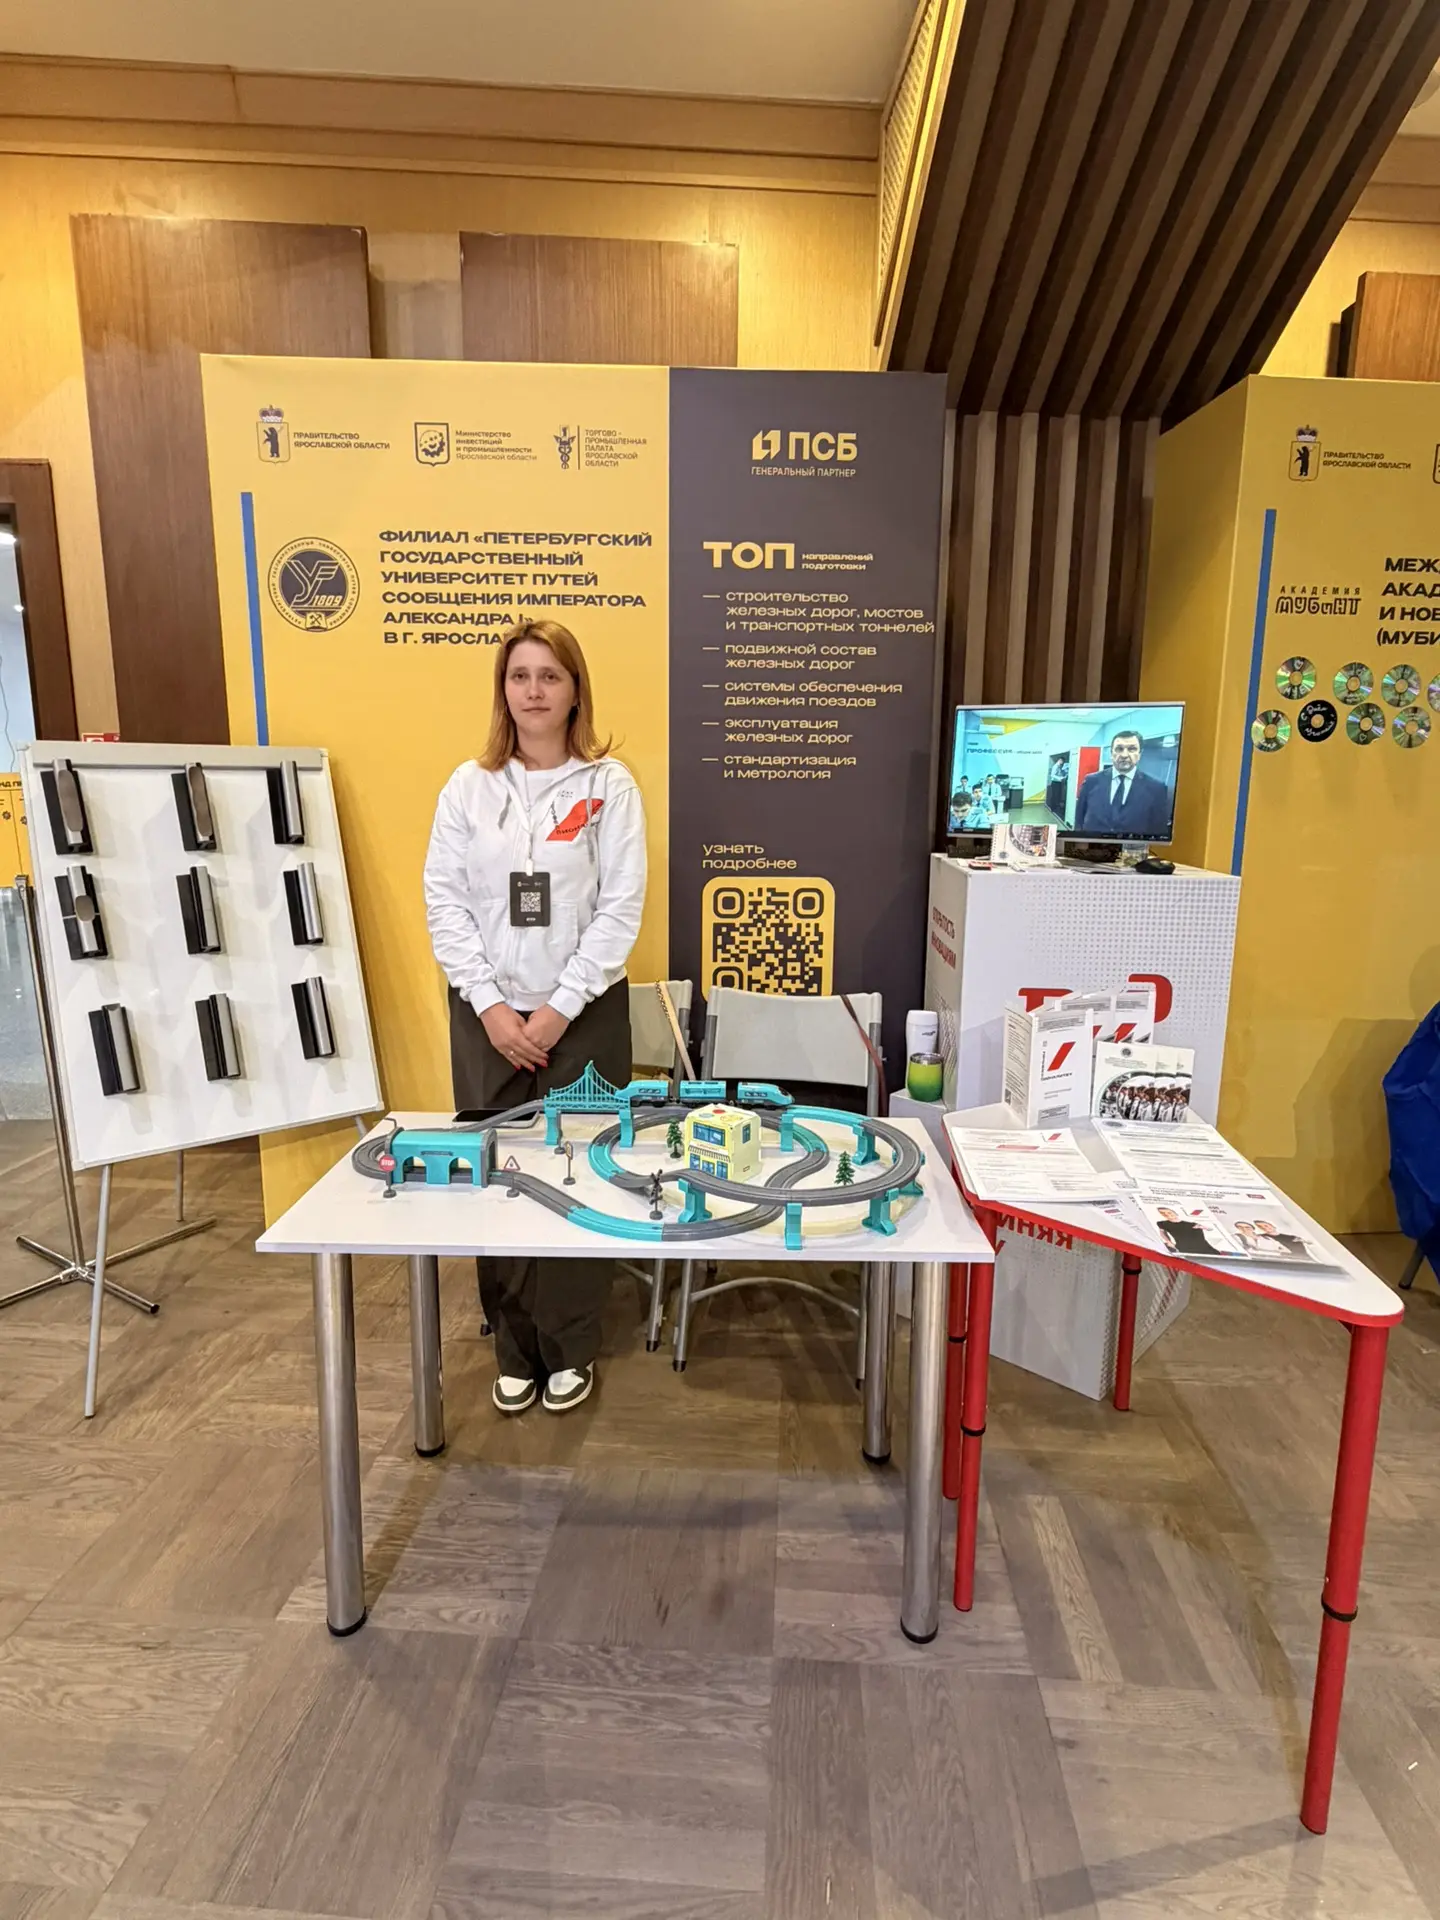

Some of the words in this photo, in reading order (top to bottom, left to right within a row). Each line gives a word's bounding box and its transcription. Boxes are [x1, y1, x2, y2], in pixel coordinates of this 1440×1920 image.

[293, 432, 360, 440] ПРАВИТЕЛЬСТВО
[455, 431, 511, 439] Министерство
[585, 437, 647, 445] ПРОМЫШЛЕННАЯ
[294, 440, 353, 449] ЯРОСЛАВСКОЙ
[353, 441, 390, 449] ОБЛАСТИ
[455, 438, 503, 446] инвестиций
[788, 431, 858, 461] ПСБ
[462, 446, 532, 454] промышленности
[585, 452, 638, 460] ЯРОСЛАВСКОЙ
[1323, 451, 1385, 459] ПРАВИТЕЛЬСТВО
[585, 459, 619, 467] ОБЛАСТИ
[1322, 460, 1376, 469] ЯРОСЛАВСКОЙ
[1377, 461, 1411, 470] ОБЛАСТИ
[751, 466, 815, 476] ГЕНЕРАЛЬНЫЙ
[817, 467, 856, 478] ПАРТНЕР
[379, 530, 469, 543] ФИЛИАЛ
[474, 531, 652, 547] «ПЕТЕРБУРГСКИЙ
[380, 550, 583, 566] ГОСУДАРСТВЕННЫЙ
[703, 541, 796, 569] ТОП
[802, 552, 874, 562] направлений
[802, 562, 866, 571] подготовки
[1384, 557, 1440, 574] МЕЖ
[381, 571, 528, 585] УНИВЕРСИТЕТ
[532, 571, 598, 586] ПУТЕЙ
[1280, 585, 1361, 596] АКАДЕМИЯ
[311, 595, 343, 607] 1809
[382, 591, 513, 606] СООБЩЕНИЯ
[517, 593, 647, 607] ИМПЕРАТОРА
[726, 591, 849, 604] строительство
[383, 611, 514, 626] АЛЕКСАНДРА
[726, 606, 806, 617] железных
[810, 607, 860, 621] дорог,
[864, 608, 924, 619] мостов
[1379, 606, 1396, 620] И
[726, 621, 735, 630] и
[740, 621, 854, 634] транспортных
[859, 621, 935, 633] тоннелей
[384, 632, 398, 643] В
[402, 632, 418, 644] Г.
[421, 632, 503, 645] ЯРОСЛА
[725, 644, 816, 658] подвижной
[820, 645, 877, 656] состав
[725, 658, 805, 669] железных
[809, 659, 855, 671] дорог
[724, 681, 795, 692] системы
[799, 681, 902, 693] обеспечения
[724, 696, 805, 707] движения
[808, 697, 876, 708] поездов
[725, 718, 839, 731] эксплуатация
[725, 732, 803, 743] железных
[807, 733, 853, 744] дорог
[724, 754, 857, 767] стандартизация
[724, 769, 734, 778] и
[737, 769, 831, 781] метрология
[702, 844, 764, 856] узнать
[702, 858, 797, 871] подробнее
[380, 1159, 395, 1167] STOP
